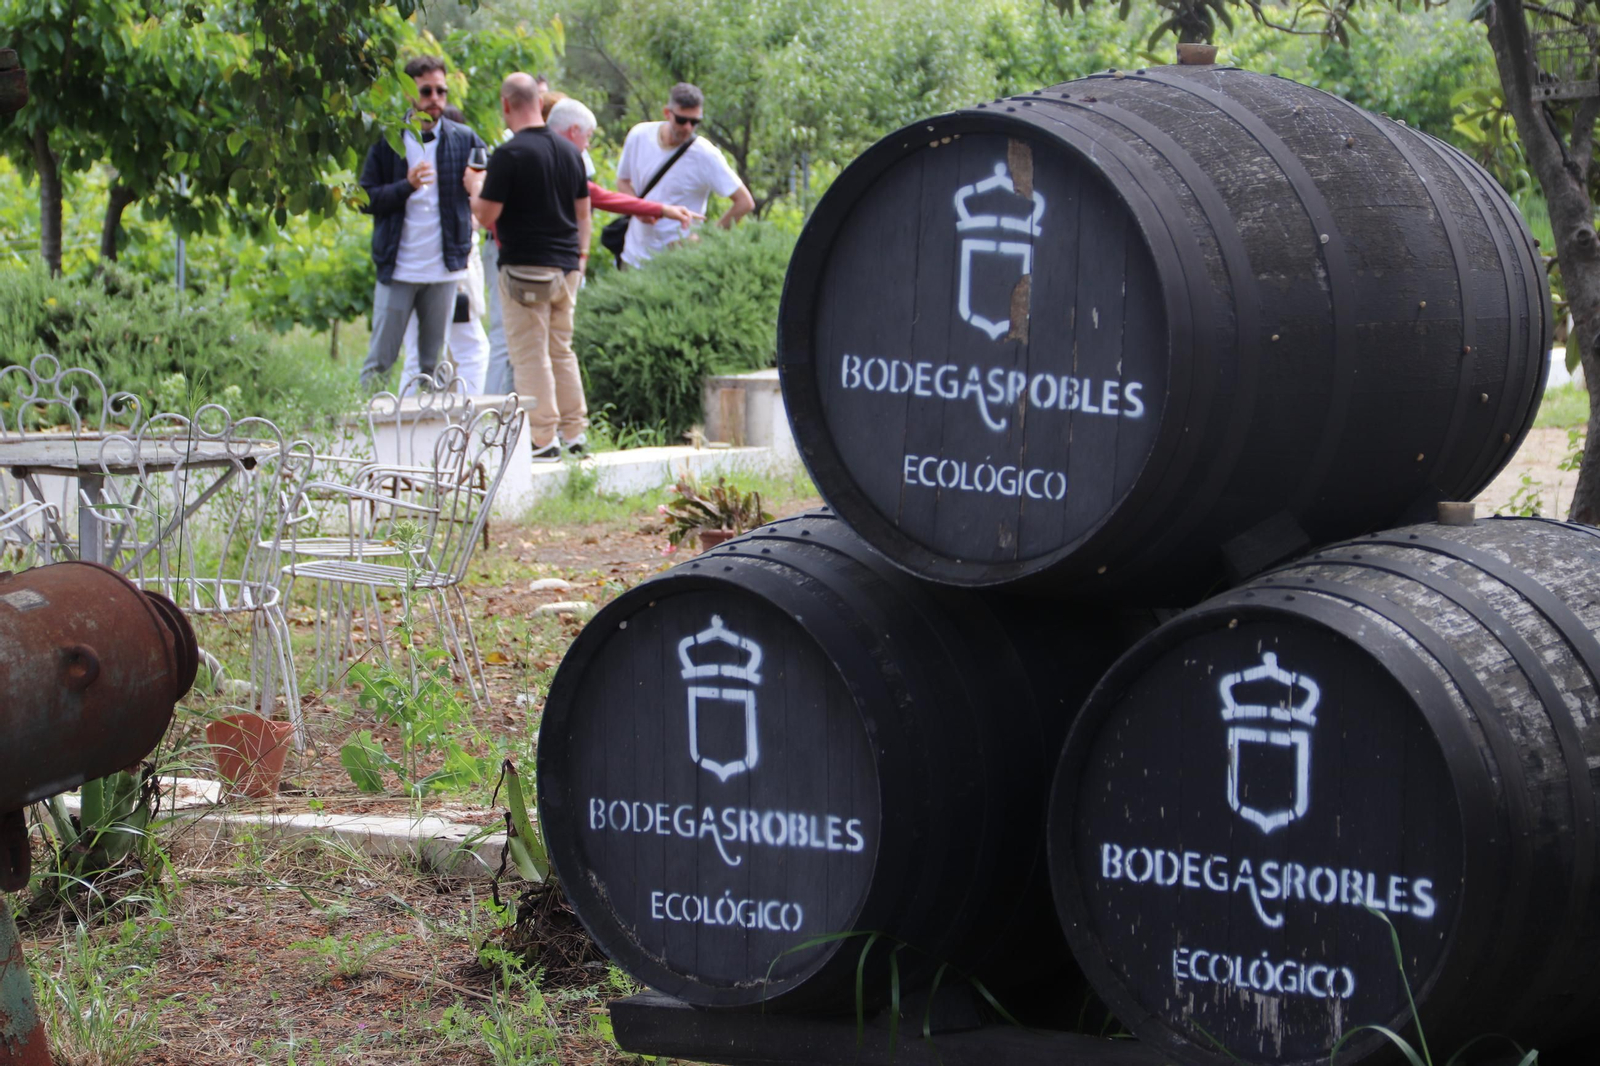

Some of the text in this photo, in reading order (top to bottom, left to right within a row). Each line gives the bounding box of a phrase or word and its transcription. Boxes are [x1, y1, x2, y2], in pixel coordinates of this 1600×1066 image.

[903, 454, 1067, 501] ECOLÓGICO
[651, 890, 803, 932] ECOLÓGICO
[1172, 948, 1355, 999] ECOLÓGICO
